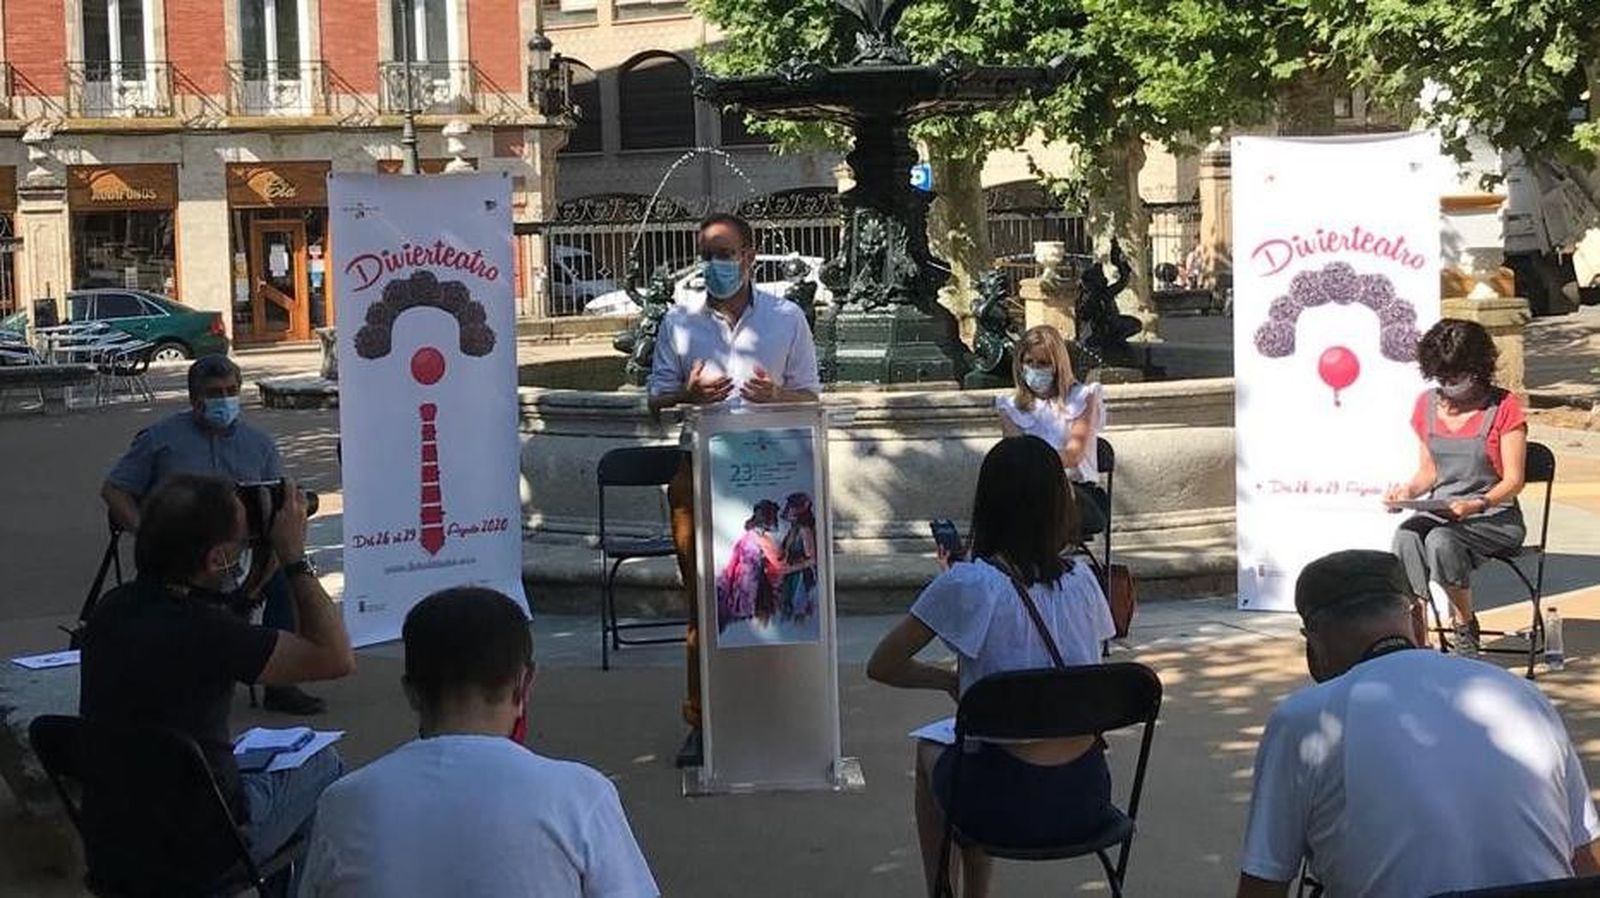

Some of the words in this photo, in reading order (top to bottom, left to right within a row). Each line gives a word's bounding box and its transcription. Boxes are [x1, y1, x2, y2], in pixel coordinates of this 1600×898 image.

[345, 239, 499, 292] Divierteatro
[1251, 225, 1425, 277] Divierteatro
[353, 534, 375, 548] Del
[375, 529, 389, 545] 26
[403, 529, 416, 542] 29
[481, 518, 508, 532] 2020
